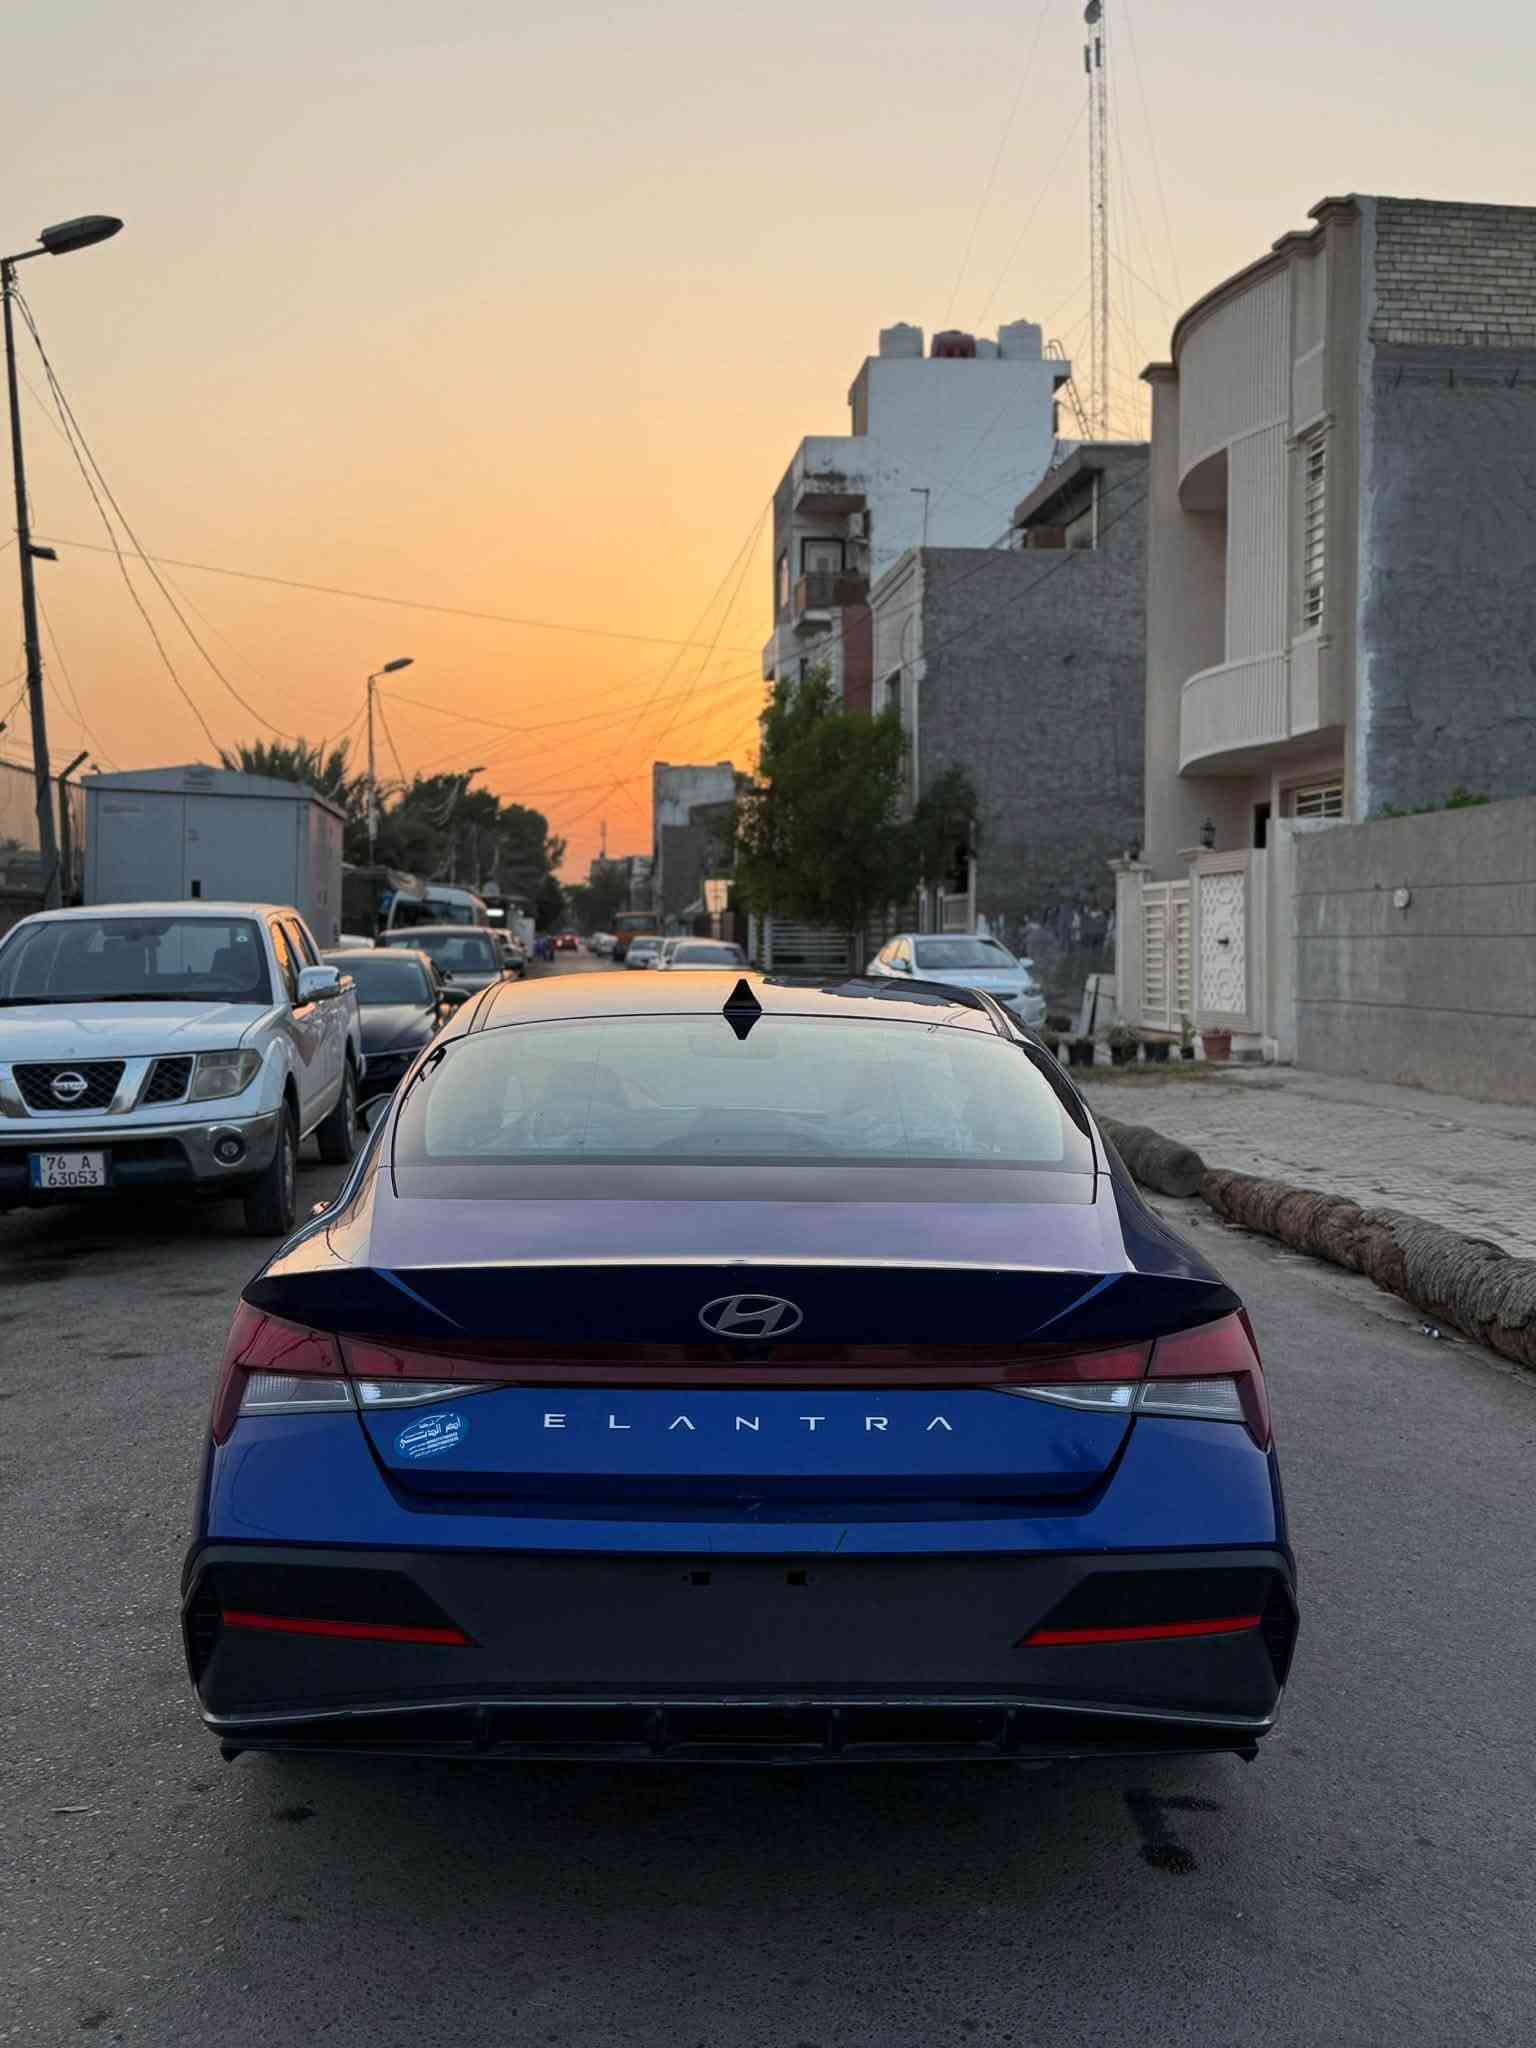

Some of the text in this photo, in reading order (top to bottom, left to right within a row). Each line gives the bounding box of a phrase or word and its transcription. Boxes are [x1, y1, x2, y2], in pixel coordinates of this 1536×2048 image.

[47, 1155, 91, 1170] 76 A
[48, 1170, 98, 1186] 63053
[543, 1413, 952, 1430] ELANTRA
